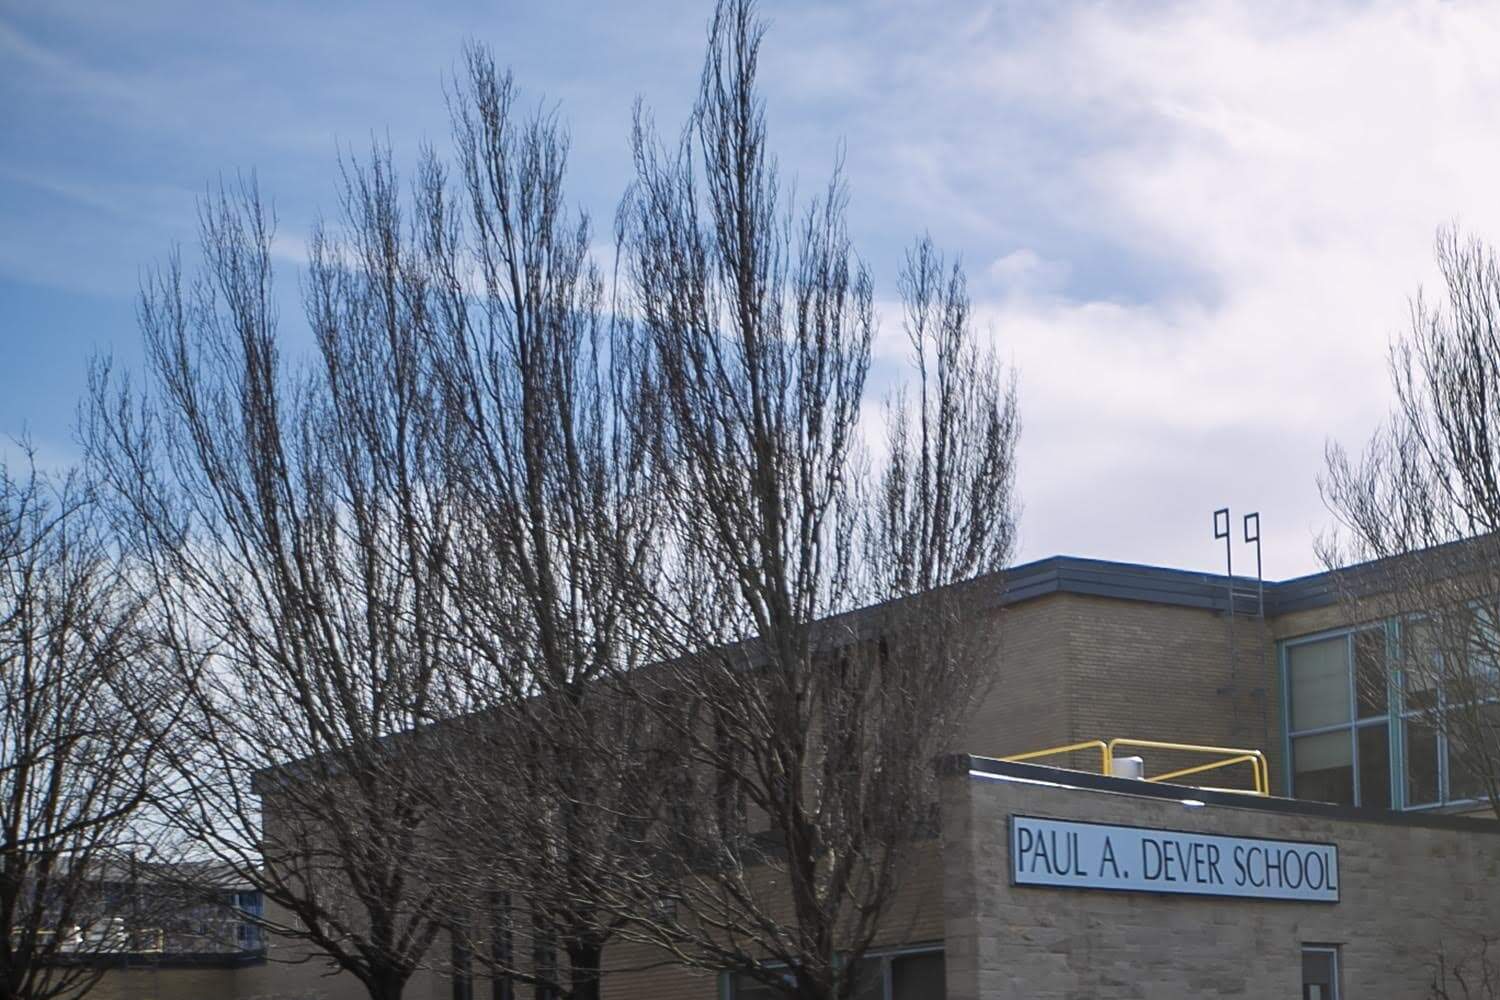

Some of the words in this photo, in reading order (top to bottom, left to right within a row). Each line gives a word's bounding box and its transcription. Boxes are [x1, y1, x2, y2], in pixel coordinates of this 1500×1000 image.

[1018, 827, 1087, 876] PAUL
[1099, 836, 1129, 879] A.
[1142, 838, 1224, 885] DEVER
[1233, 845, 1337, 891] SCHOOL
